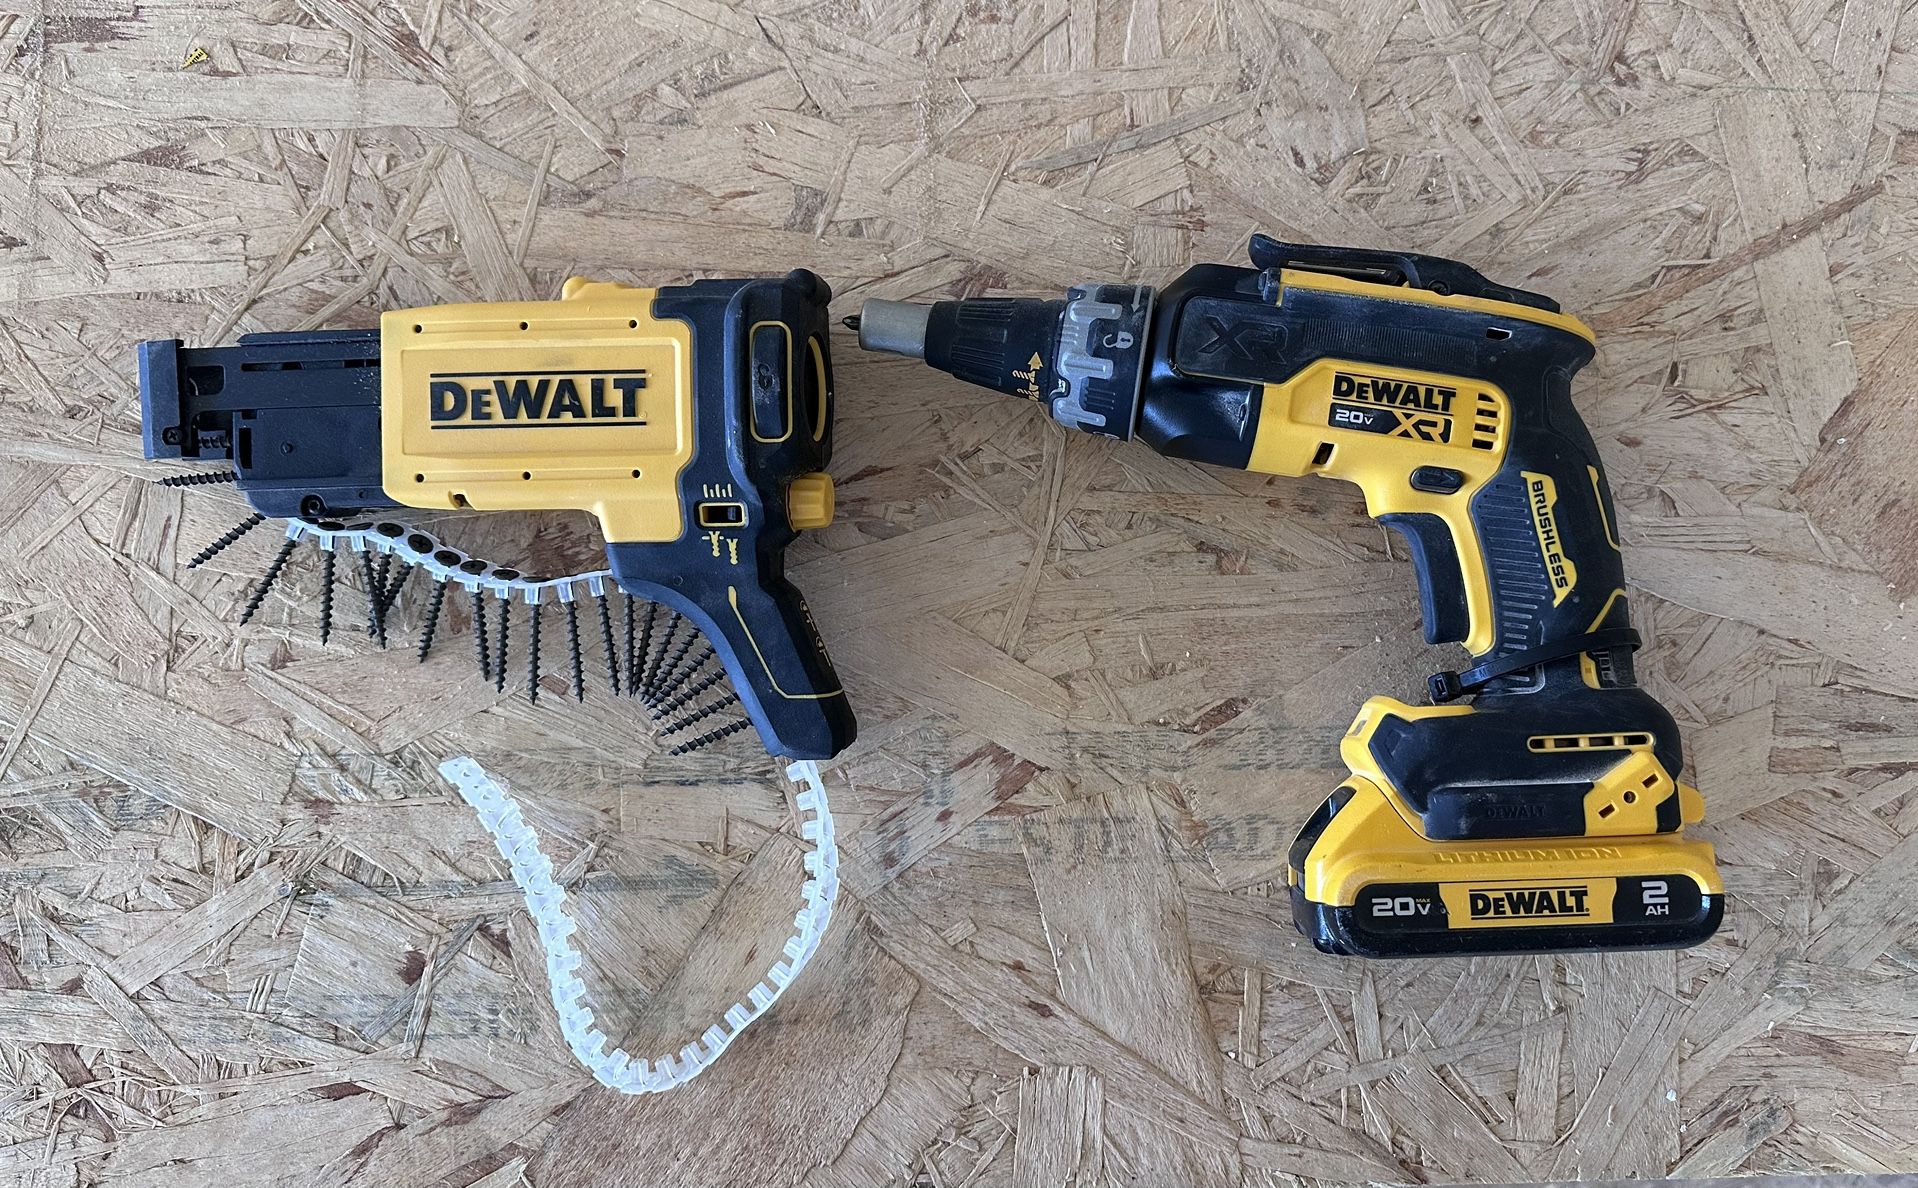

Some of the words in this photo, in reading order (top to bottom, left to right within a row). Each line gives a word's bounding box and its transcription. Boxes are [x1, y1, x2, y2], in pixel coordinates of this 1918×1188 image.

[1387, 411, 1453, 443] XR
[1532, 480, 1569, 588] BRUSHLESS
[1433, 850, 1560, 863] LITHIUM
[1566, 848, 1622, 859] ION
[1641, 881, 1670, 904] 2
[1645, 905, 1670, 916] AH
